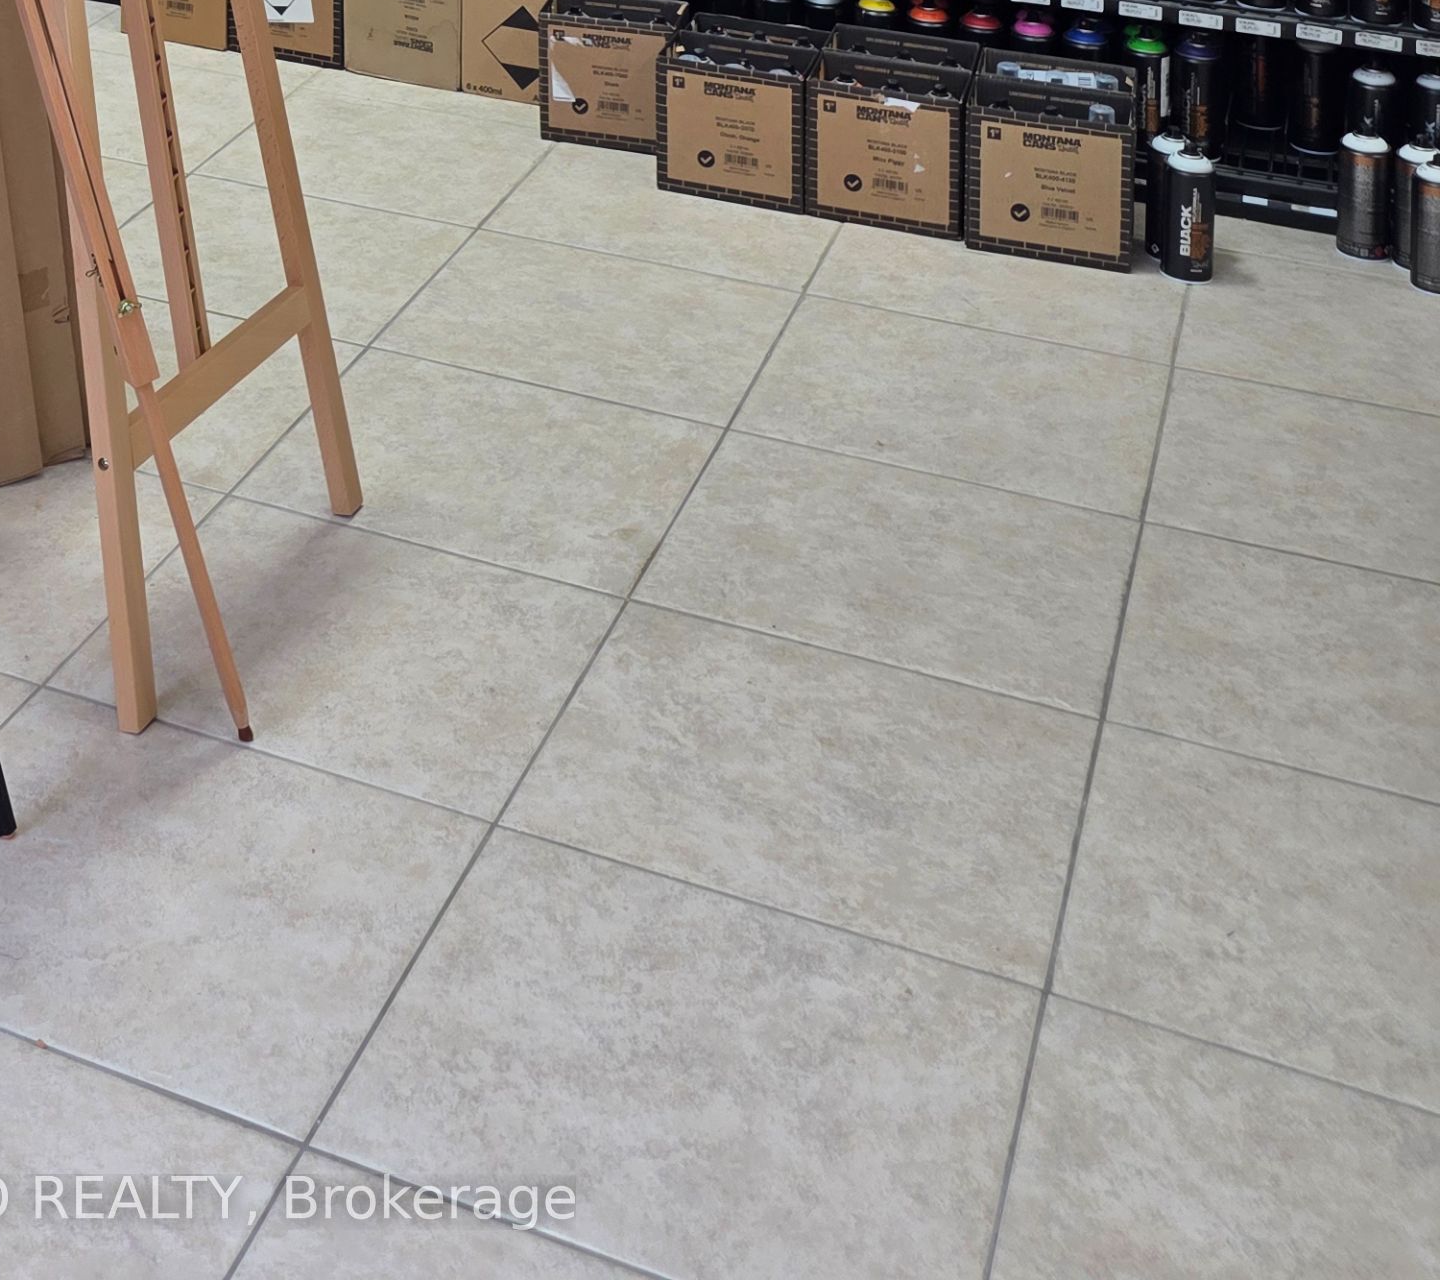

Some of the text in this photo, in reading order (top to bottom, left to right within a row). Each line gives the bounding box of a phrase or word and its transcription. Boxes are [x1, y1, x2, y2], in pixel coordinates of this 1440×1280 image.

[582, 33, 632, 46] MONTANA
[704, 81, 756, 96] MONTANA
[704, 90, 733, 99] CANS
[856, 106, 911, 120] MONTANA
[1023, 132, 1081, 147] MONTANA
[1023, 140, 1056, 150] CANS
[1180, 204, 1192, 256] BLACK
